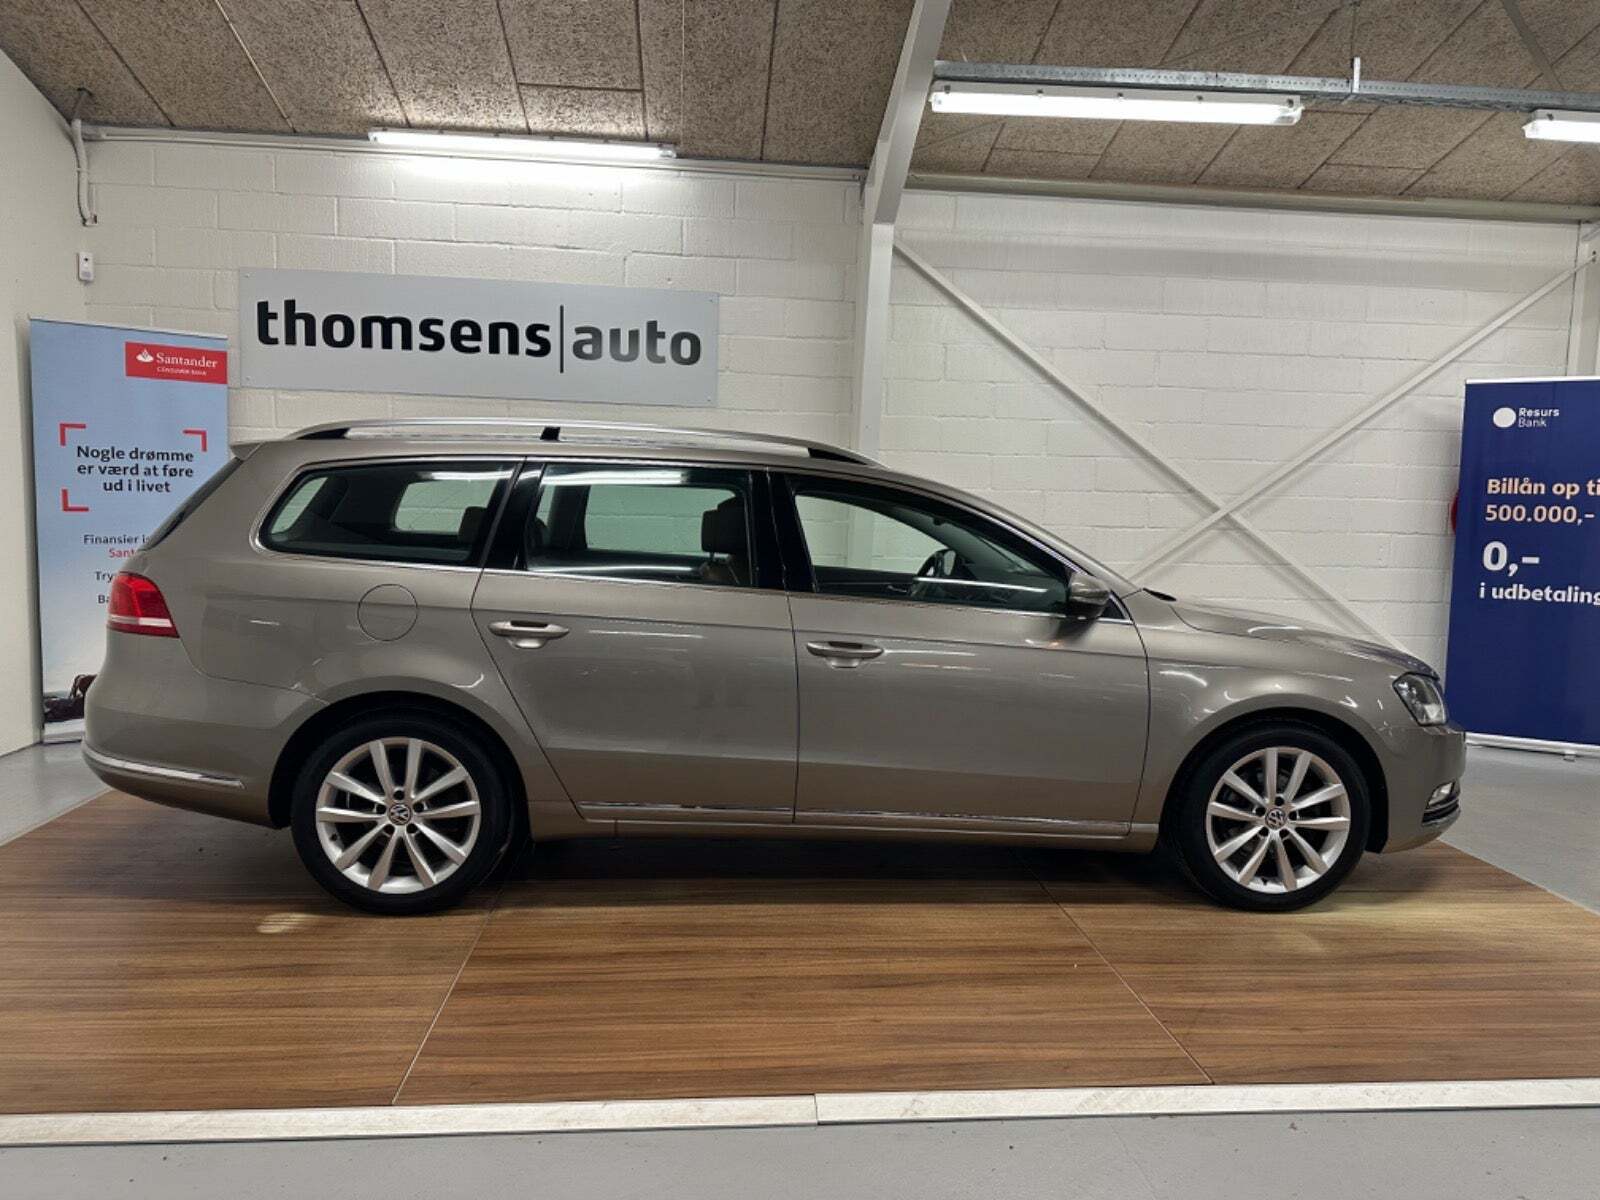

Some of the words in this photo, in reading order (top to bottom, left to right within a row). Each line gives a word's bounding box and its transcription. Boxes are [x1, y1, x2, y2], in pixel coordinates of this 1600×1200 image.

[257, 298, 551, 358] thomsens
[572, 319, 701, 366] auto
[156, 352, 218, 369] Santander
[1518, 407, 1560, 417] Resurs
[1518, 418, 1547, 428] Bank
[77, 446, 125, 462] Nogle
[129, 447, 194, 463] drømme
[77, 465, 95, 475] er
[98, 463, 139, 476] værd
[143, 465, 160, 477] at
[163, 463, 194, 478] føre
[103, 479, 123, 492] ud
[127, 480, 132, 492] i
[136, 480, 171, 493] livet
[1486, 477, 1546, 496] Billån
[1552, 482, 1580, 500] op
[83, 534, 138, 545] Finansier
[95, 571, 114, 583] Try
[1479, 582, 1486, 599] i
